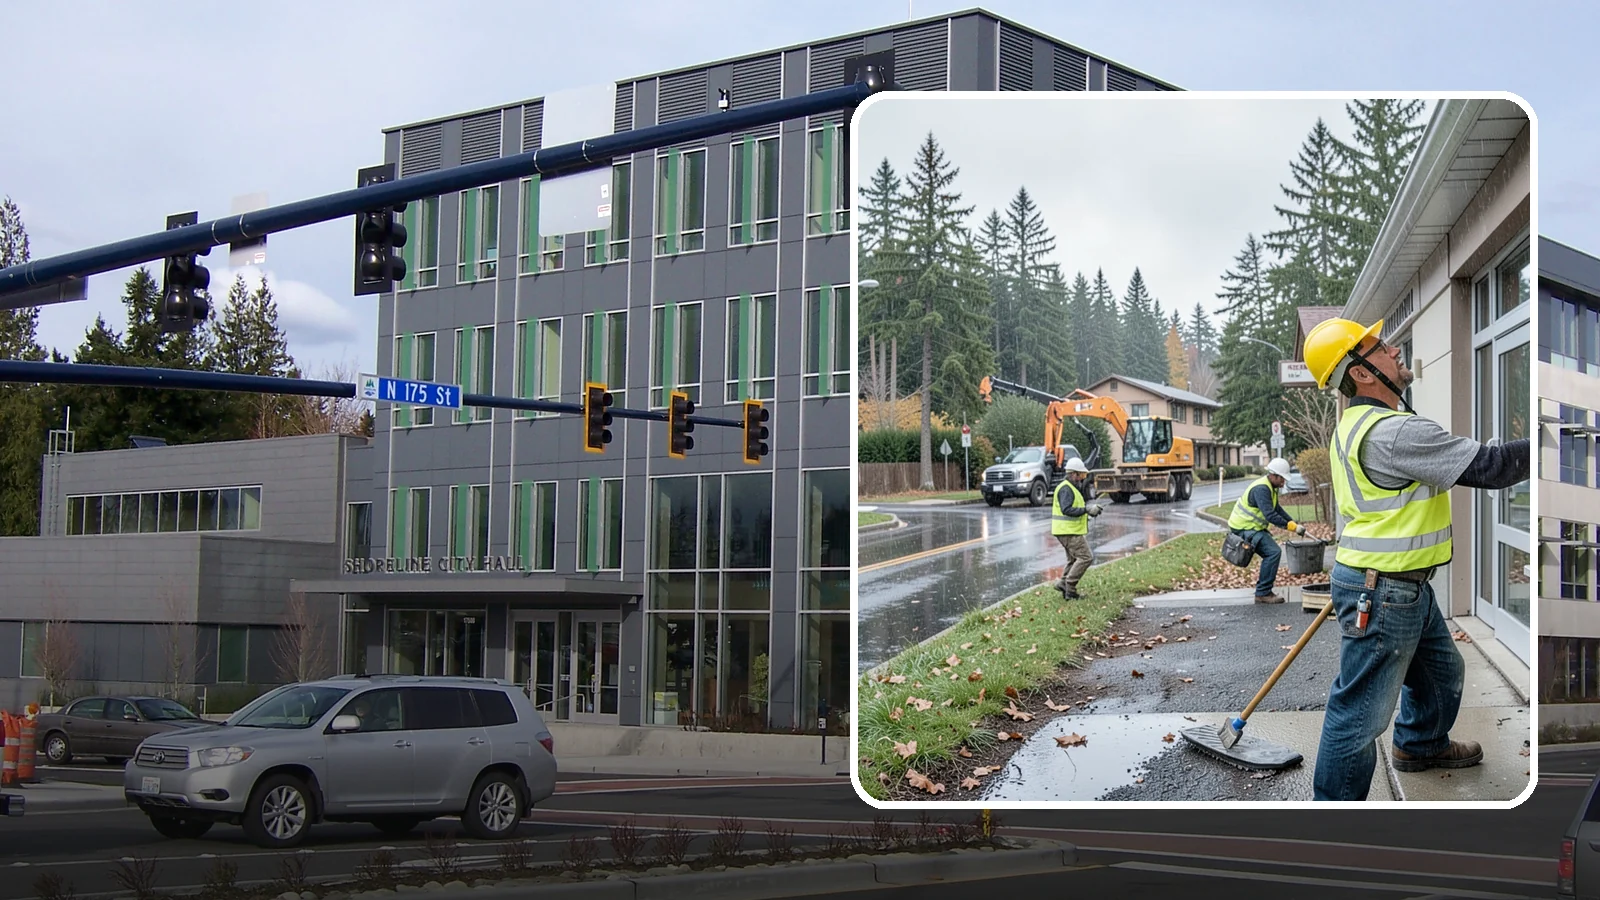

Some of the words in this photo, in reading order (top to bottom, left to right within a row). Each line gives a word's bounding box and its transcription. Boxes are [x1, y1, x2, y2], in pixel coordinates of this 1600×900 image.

[387, 380, 396, 400] N
[405, 382, 428, 403] 175
[436, 386, 451, 406] St
[343, 557, 431, 574] SHORELINE
[438, 556, 476, 573] CITY
[484, 555, 526, 572] HALL
